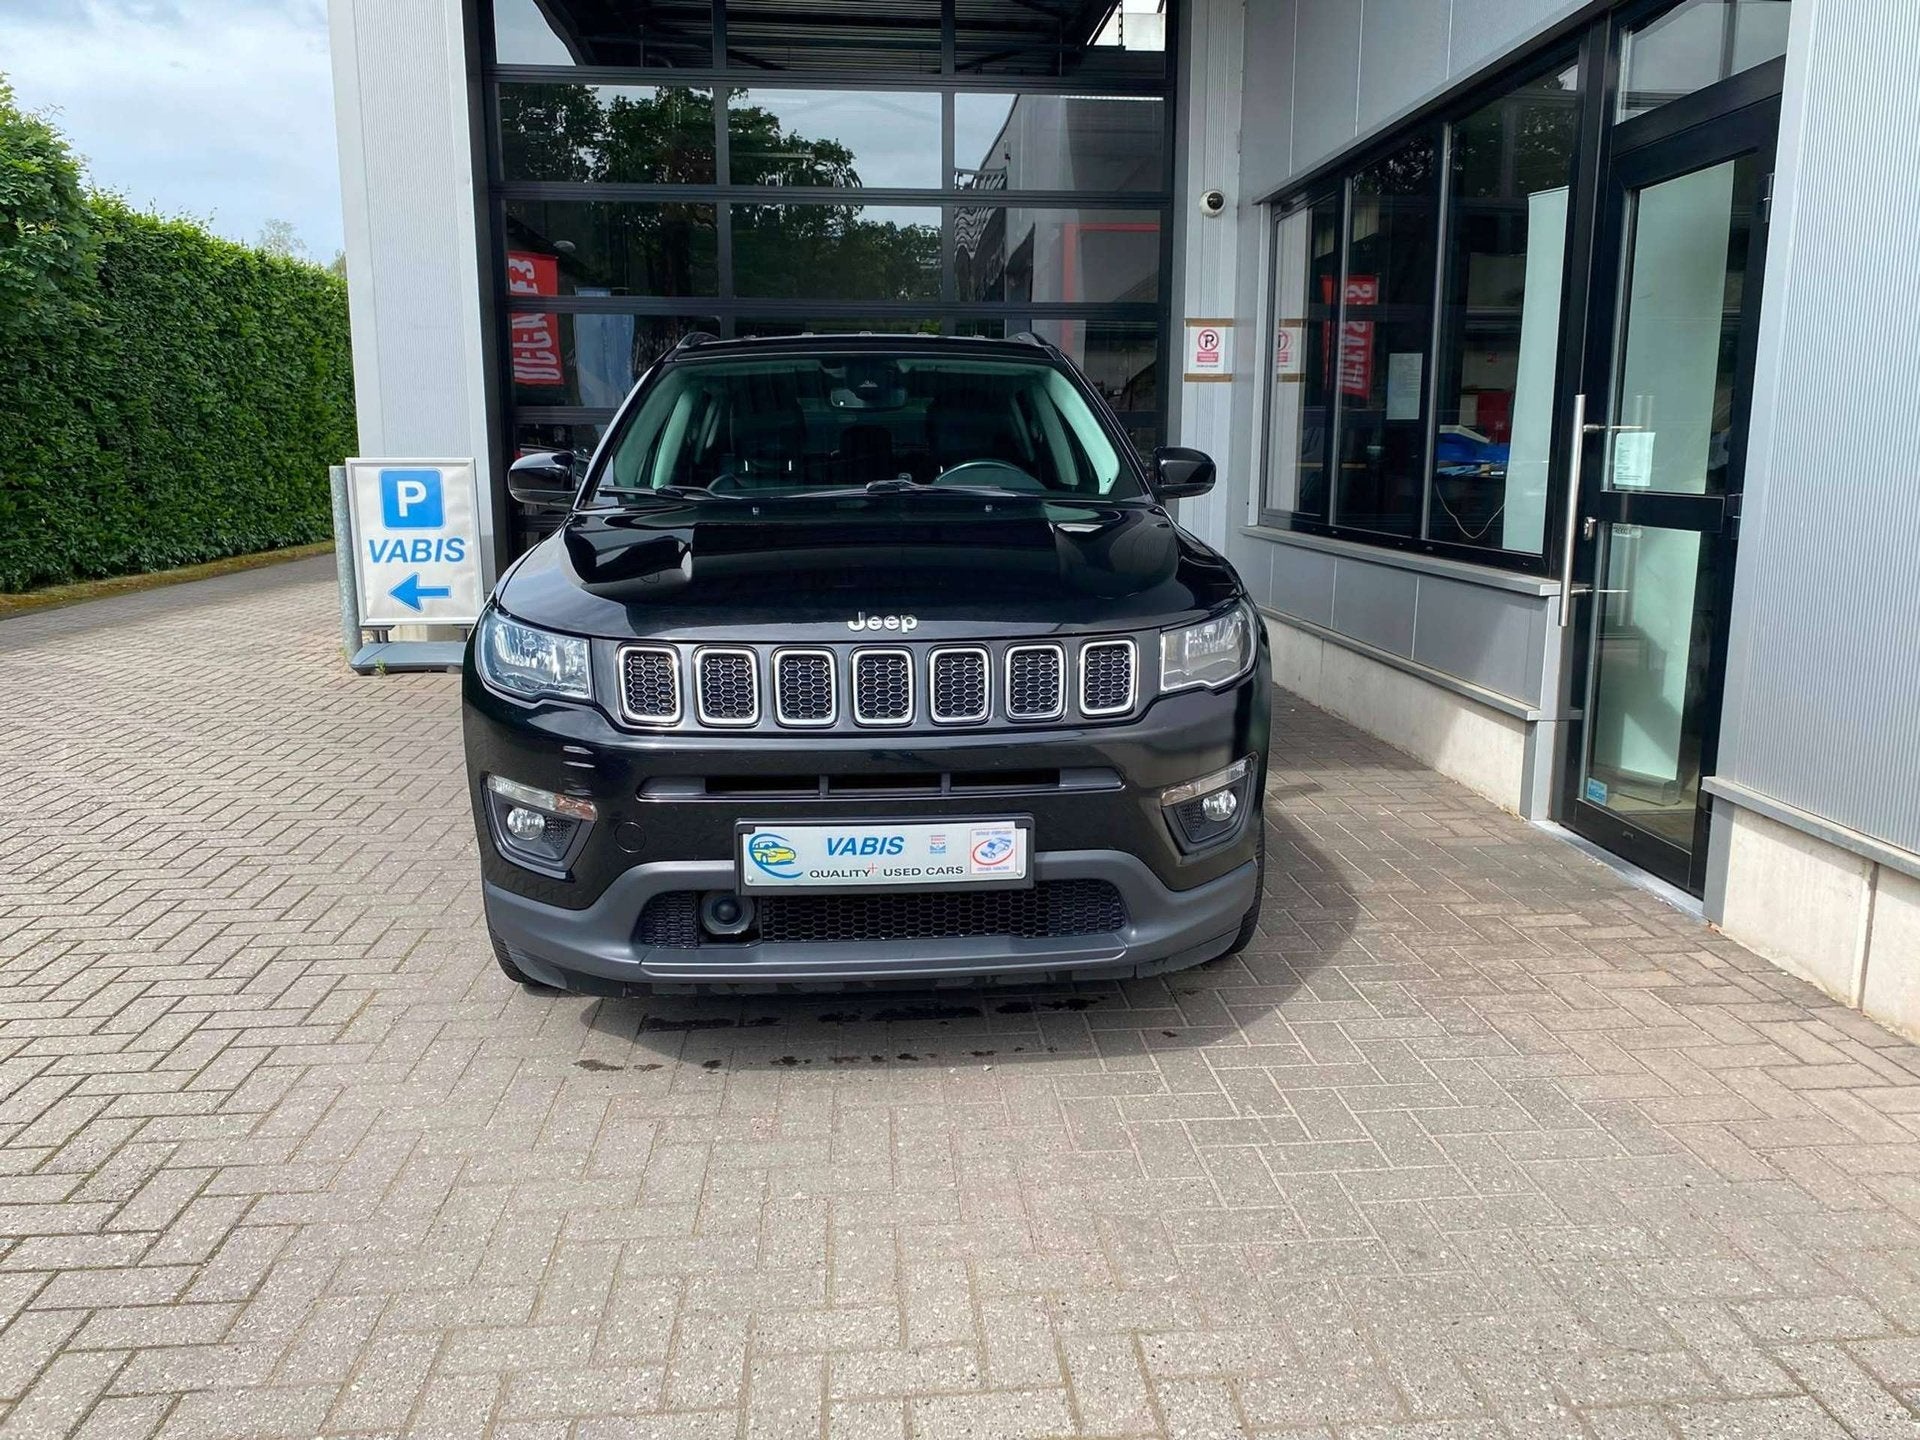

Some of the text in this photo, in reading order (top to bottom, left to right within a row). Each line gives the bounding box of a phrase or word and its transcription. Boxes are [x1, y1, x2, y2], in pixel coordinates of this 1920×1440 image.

[396, 480, 427, 517] P
[368, 537, 466, 563] VABIS
[847, 611, 918, 633] Jeep
[826, 836, 904, 856] VABIS
[809, 868, 870, 879] QUALITY
[883, 867, 921, 877] USED
[926, 865, 964, 876] CARS
